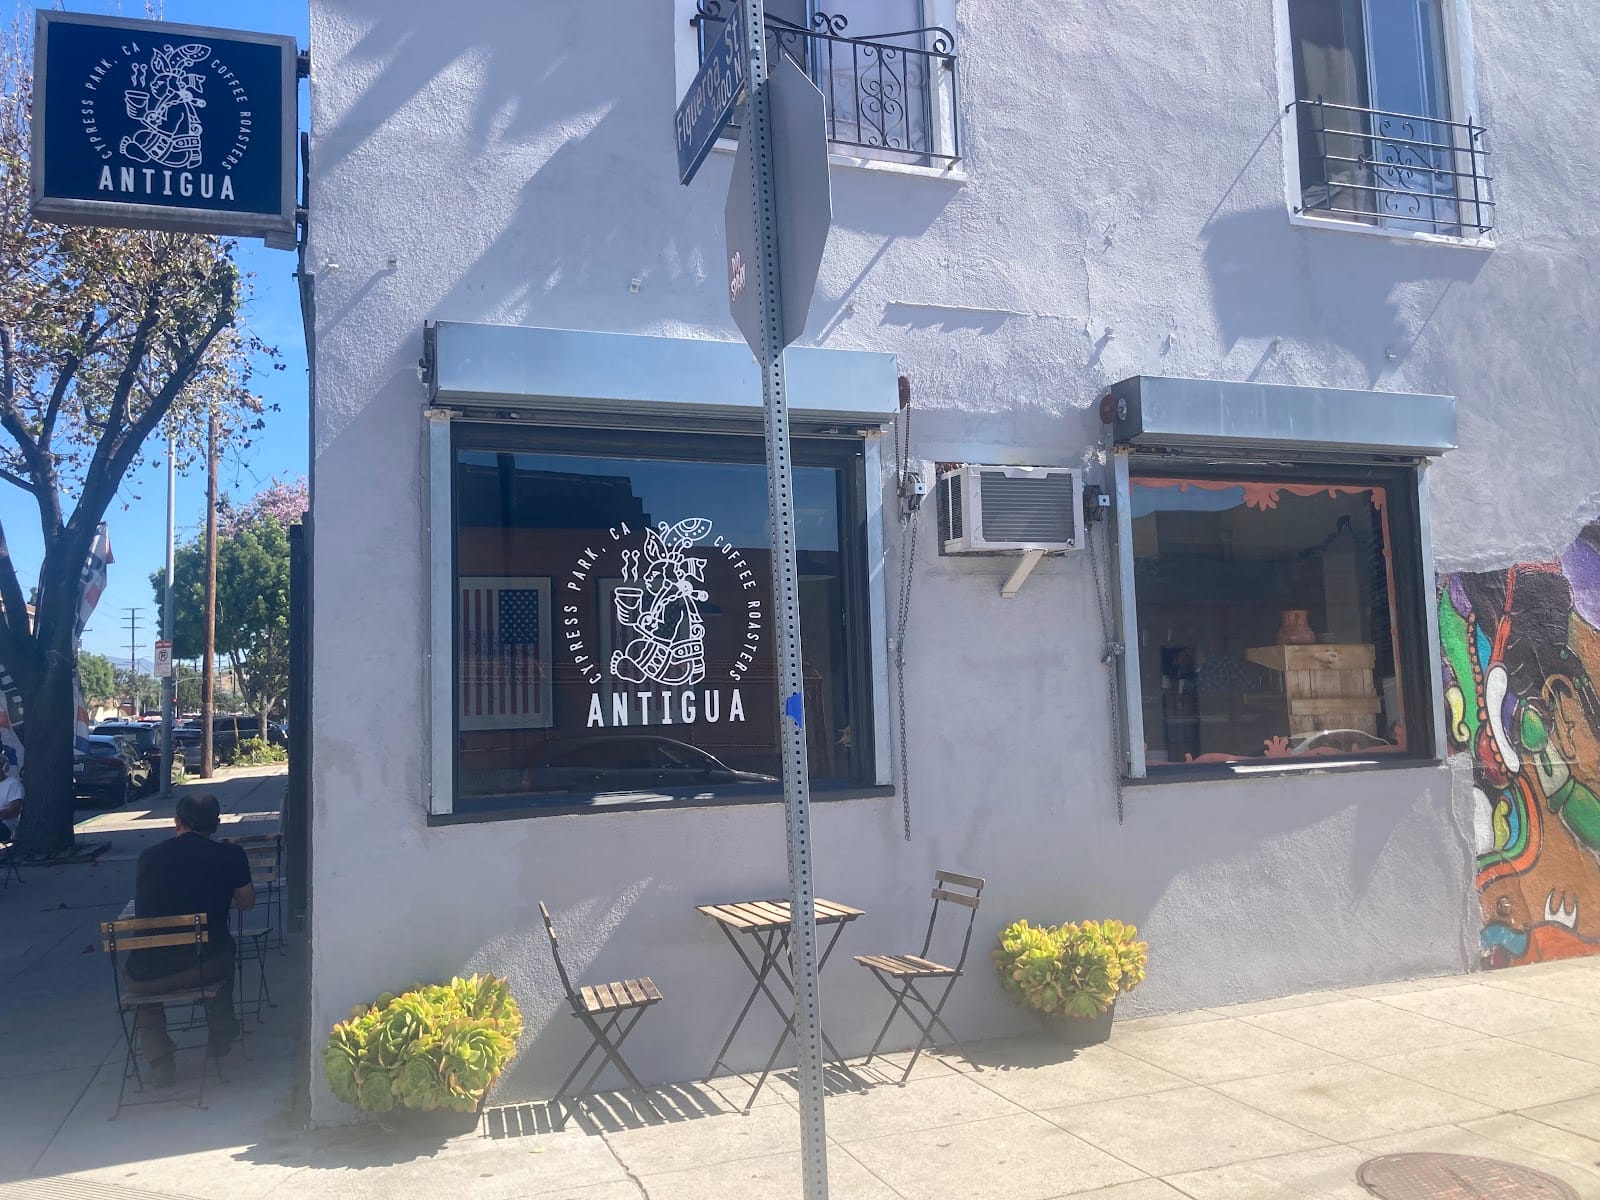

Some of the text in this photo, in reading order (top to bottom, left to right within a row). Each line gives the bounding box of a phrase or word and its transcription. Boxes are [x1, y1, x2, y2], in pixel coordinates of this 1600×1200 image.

[82, 41, 141, 160] CYPRESS PARK, CA
[210, 59, 252, 171] COFFEE ROASTERS
[676, 14, 739, 151] Figueroa St
[711, 51, 743, 123] 3400 N
[98, 164, 235, 201] ANTIGUA
[564, 521, 632, 685] CYPRESS PARK, CA
[713, 535, 761, 681] COFFEE ROASTERS
[586, 689, 745, 728] ANTIGUA
